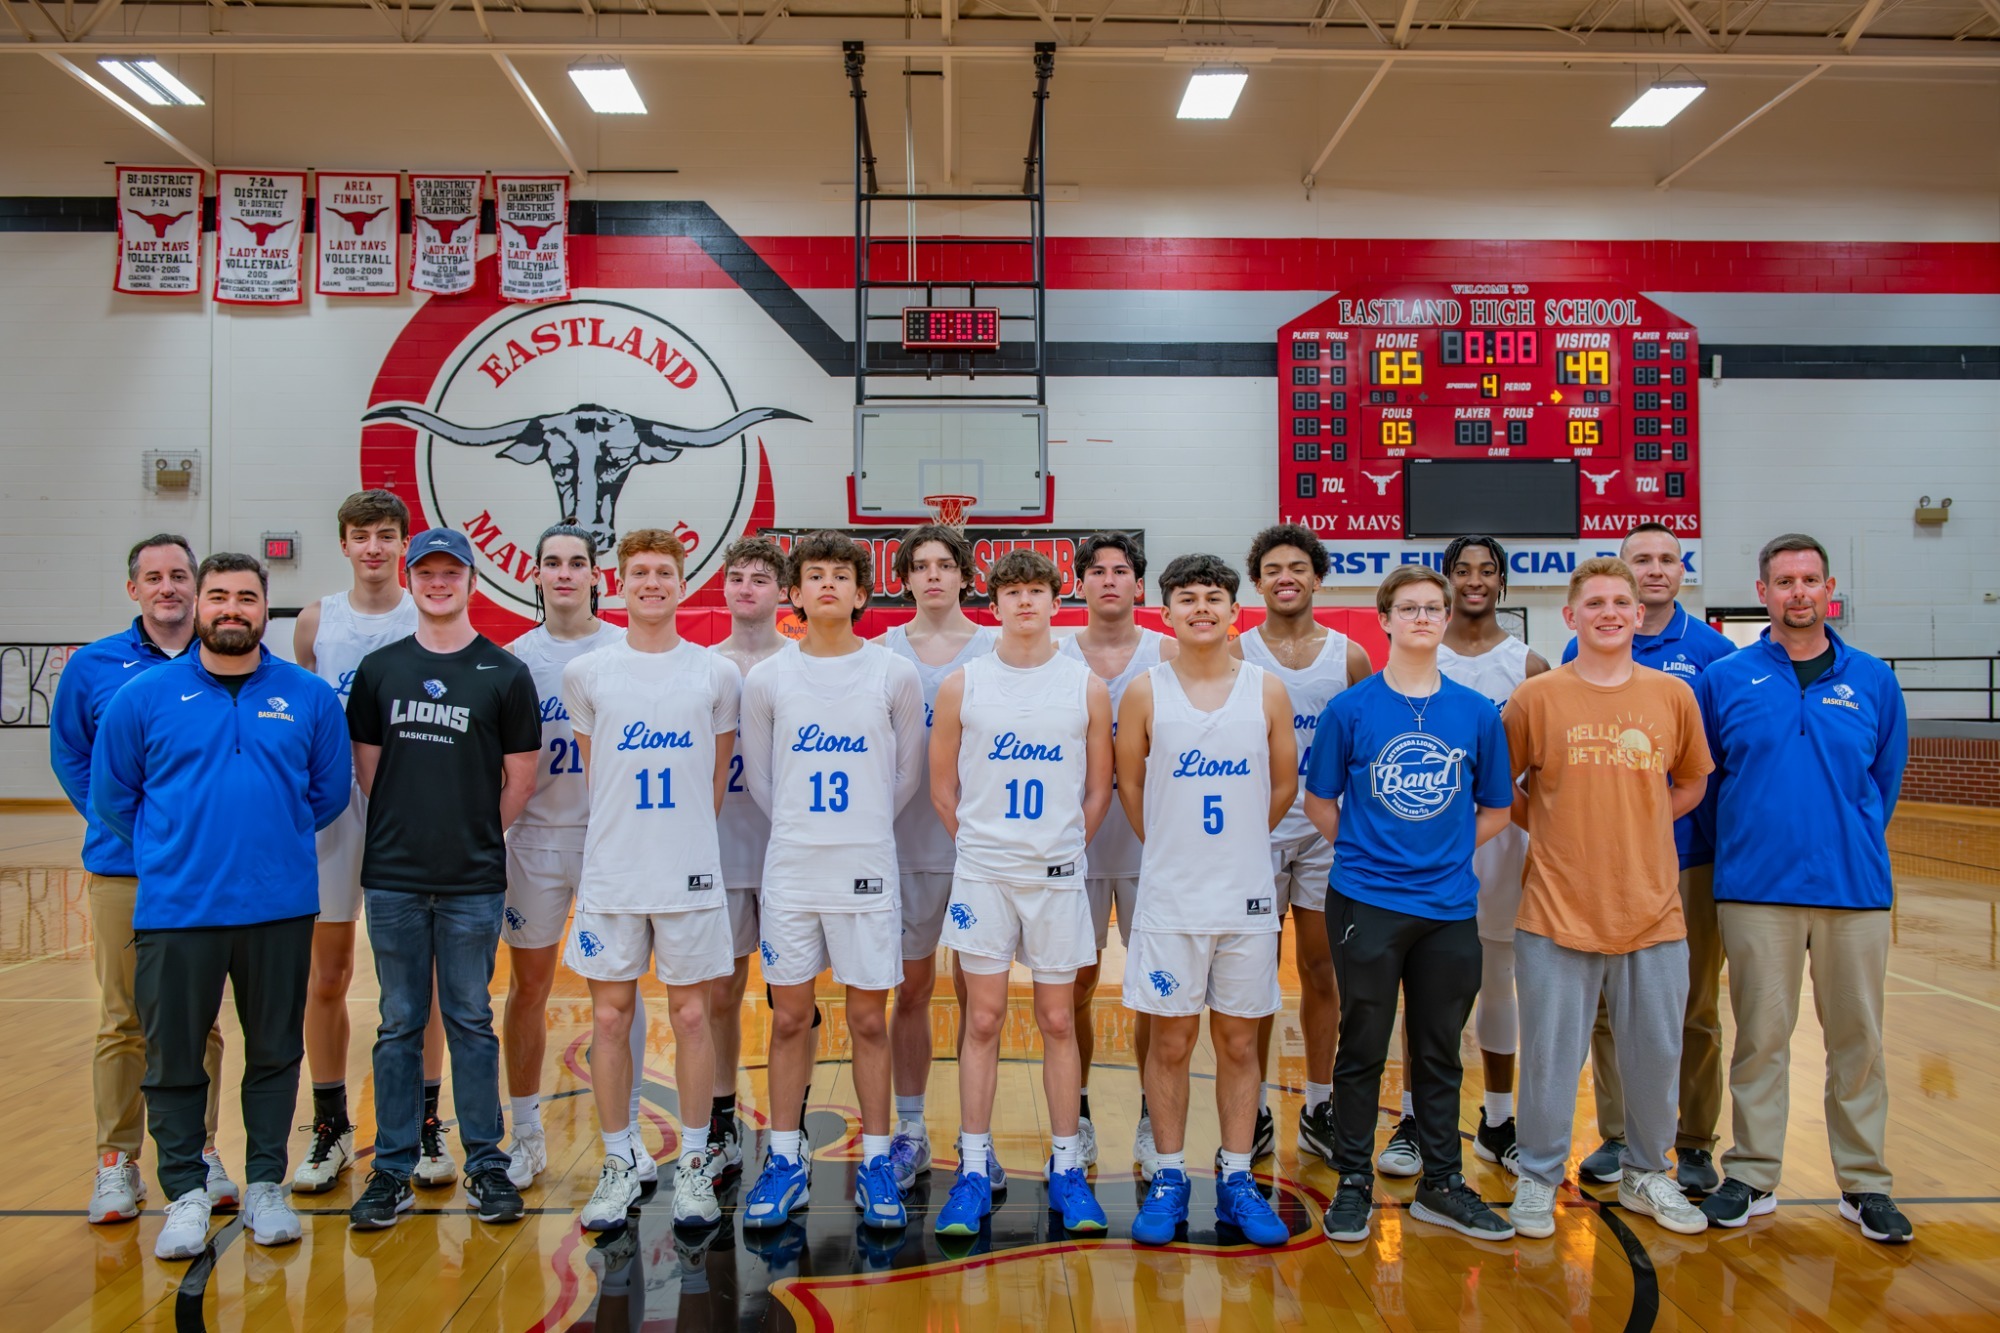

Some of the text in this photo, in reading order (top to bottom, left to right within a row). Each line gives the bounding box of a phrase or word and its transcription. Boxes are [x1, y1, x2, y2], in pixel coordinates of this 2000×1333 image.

[127, 174, 194, 185] BI-DISTRICT
[249, 177, 274, 187] 7-2A
[434, 180, 476, 189] DISTRICT
[344, 181, 373, 191] AREA
[519, 183, 561, 192] DISTRICT
[129, 187, 192, 198] CHAMPIONS
[234, 188, 288, 199] DISTRICT
[420, 188, 472, 198] CHAMPIONS
[507, 193, 555, 202] CHAMPIONS
[151, 199, 170, 207] 7-2A
[333, 194, 383, 205] FINALIST
[240, 208, 282, 218] CHAMPIONS
[421, 205, 471, 215] CHAMPIONS
[507, 203, 555, 212] BI-DISTRICT
[508, 212, 555, 221] CHAMPIONS
[127, 241, 190, 251] LADY MAVS
[329, 240, 387, 251] LADY MAVS
[424, 244, 468, 255] LADY MAV
[229, 247, 289, 259] LADY MAVS
[508, 249, 531, 260] LADY
[225, 259, 292, 269] VOLLEYBALL
[325, 253, 392, 265] VOLLEYBALL
[135, 265, 181, 274] 2004-2005
[247, 271, 268, 279] 2005
[333, 267, 383, 275] 2008-2009
[1451, 284, 1529, 294] WELCOME TO
[1338, 299, 1642, 326] EASTLAND HIGH SCHOOL
[1292, 332, 1349, 340] PLAYER FOULS
[1375, 333, 1419, 349] HOME
[1555, 333, 1611, 349] VISITOR
[1632, 332, 1690, 341] PLAYER FOULS
[478, 317, 698, 390] EASTLAND
[1380, 351, 1423, 385] 65
[1566, 351, 1609, 385] 49
[1483, 374, 1498, 398] 4
[1504, 382, 1532, 392] PERIOD
[1382, 408, 1412, 419] FOULS
[1454, 408, 1534, 419] PLAYER FOULS
[1568, 408, 1599, 418] FOULS
[1382, 422, 1412, 445] 05
[1569, 421, 1599, 444] 05
[1387, 448, 1405, 457] WON
[1488, 447, 1510, 457] GAME
[1574, 447, 1593, 457] WON
[1322, 478, 1345, 493] TOL
[1636, 477, 1659, 492] TOL
[1285, 514, 1401, 531] LADY MAVS
[268, 540, 289, 557] EXIT
[1328, 552, 1390, 574] RST
[1663, 661, 1696, 675] LIONS
[1822, 697, 1860, 710] BASKETBALL
[258, 711, 295, 722] BASKETBALL
[390, 699, 470, 733] LIONS
[399, 731, 454, 744] BASKETBALL
[617, 721, 693, 751] Lions
[792, 724, 868, 753] Lions
[988, 732, 1064, 762] Lions
[550, 737, 583, 775] 21
[1173, 749, 1251, 778] Lions
[1377, 748, 1467, 805] Band
[636, 767, 676, 810] 11
[809, 771, 849, 813] 13
[1005, 779, 1044, 820] 10
[1203, 795, 1224, 835] 5
